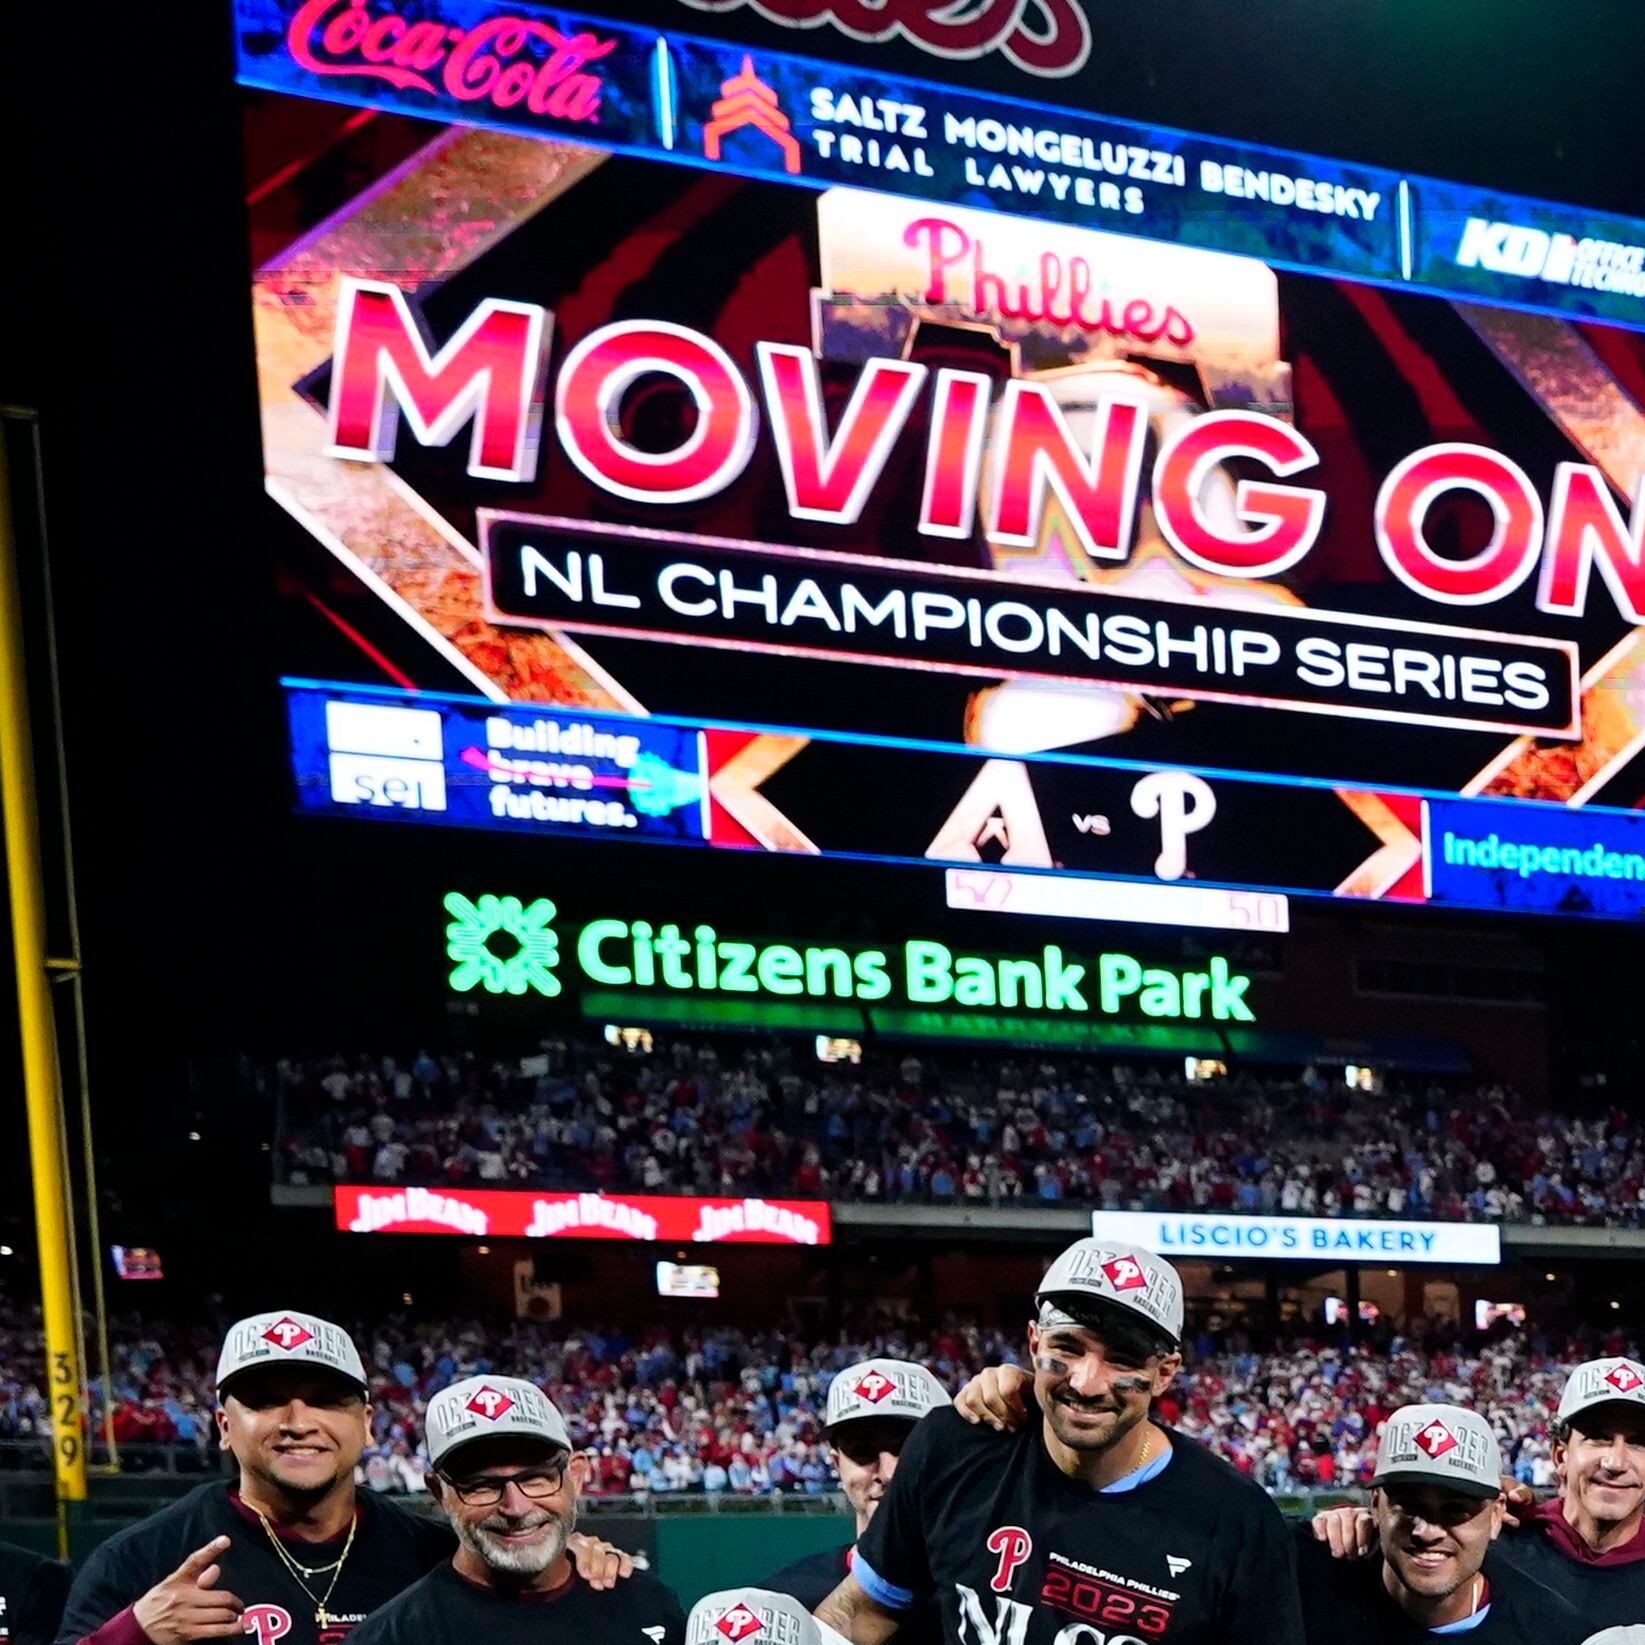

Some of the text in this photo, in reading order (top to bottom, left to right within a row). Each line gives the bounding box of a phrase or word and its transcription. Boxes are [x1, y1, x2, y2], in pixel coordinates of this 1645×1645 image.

[811, 87, 1380, 221] SALTZ MONGELUZZI BENDESKY
[817, 129, 1145, 213] TRIAL LAWYERS
[903, 217, 1194, 346] Phillies
[324, 277, 1327, 579] MOVING
[520, 546, 1550, 711] NL CHAMPIONSHIP SERIES
[486, 717, 641, 767] Building
[489, 785, 638, 828] futures.
[924, 758, 1054, 868] A
[1129, 771, 1217, 880] P
[577, 919, 1257, 1021] Citizens Bank Park
[349, 1186, 488, 1236] JIM BEAM
[525, 1192, 657, 1240] JIM BEAM
[692, 1197, 818, 1245] JIM BEAM
[1159, 1220, 1437, 1254] LISCIO'S BAKERY
[987, 1526, 1033, 1593] P
[1049, 1551, 1181, 1602] PHILADELPHIA PHILLIES
[1040, 1572, 1172, 1635] 2023
